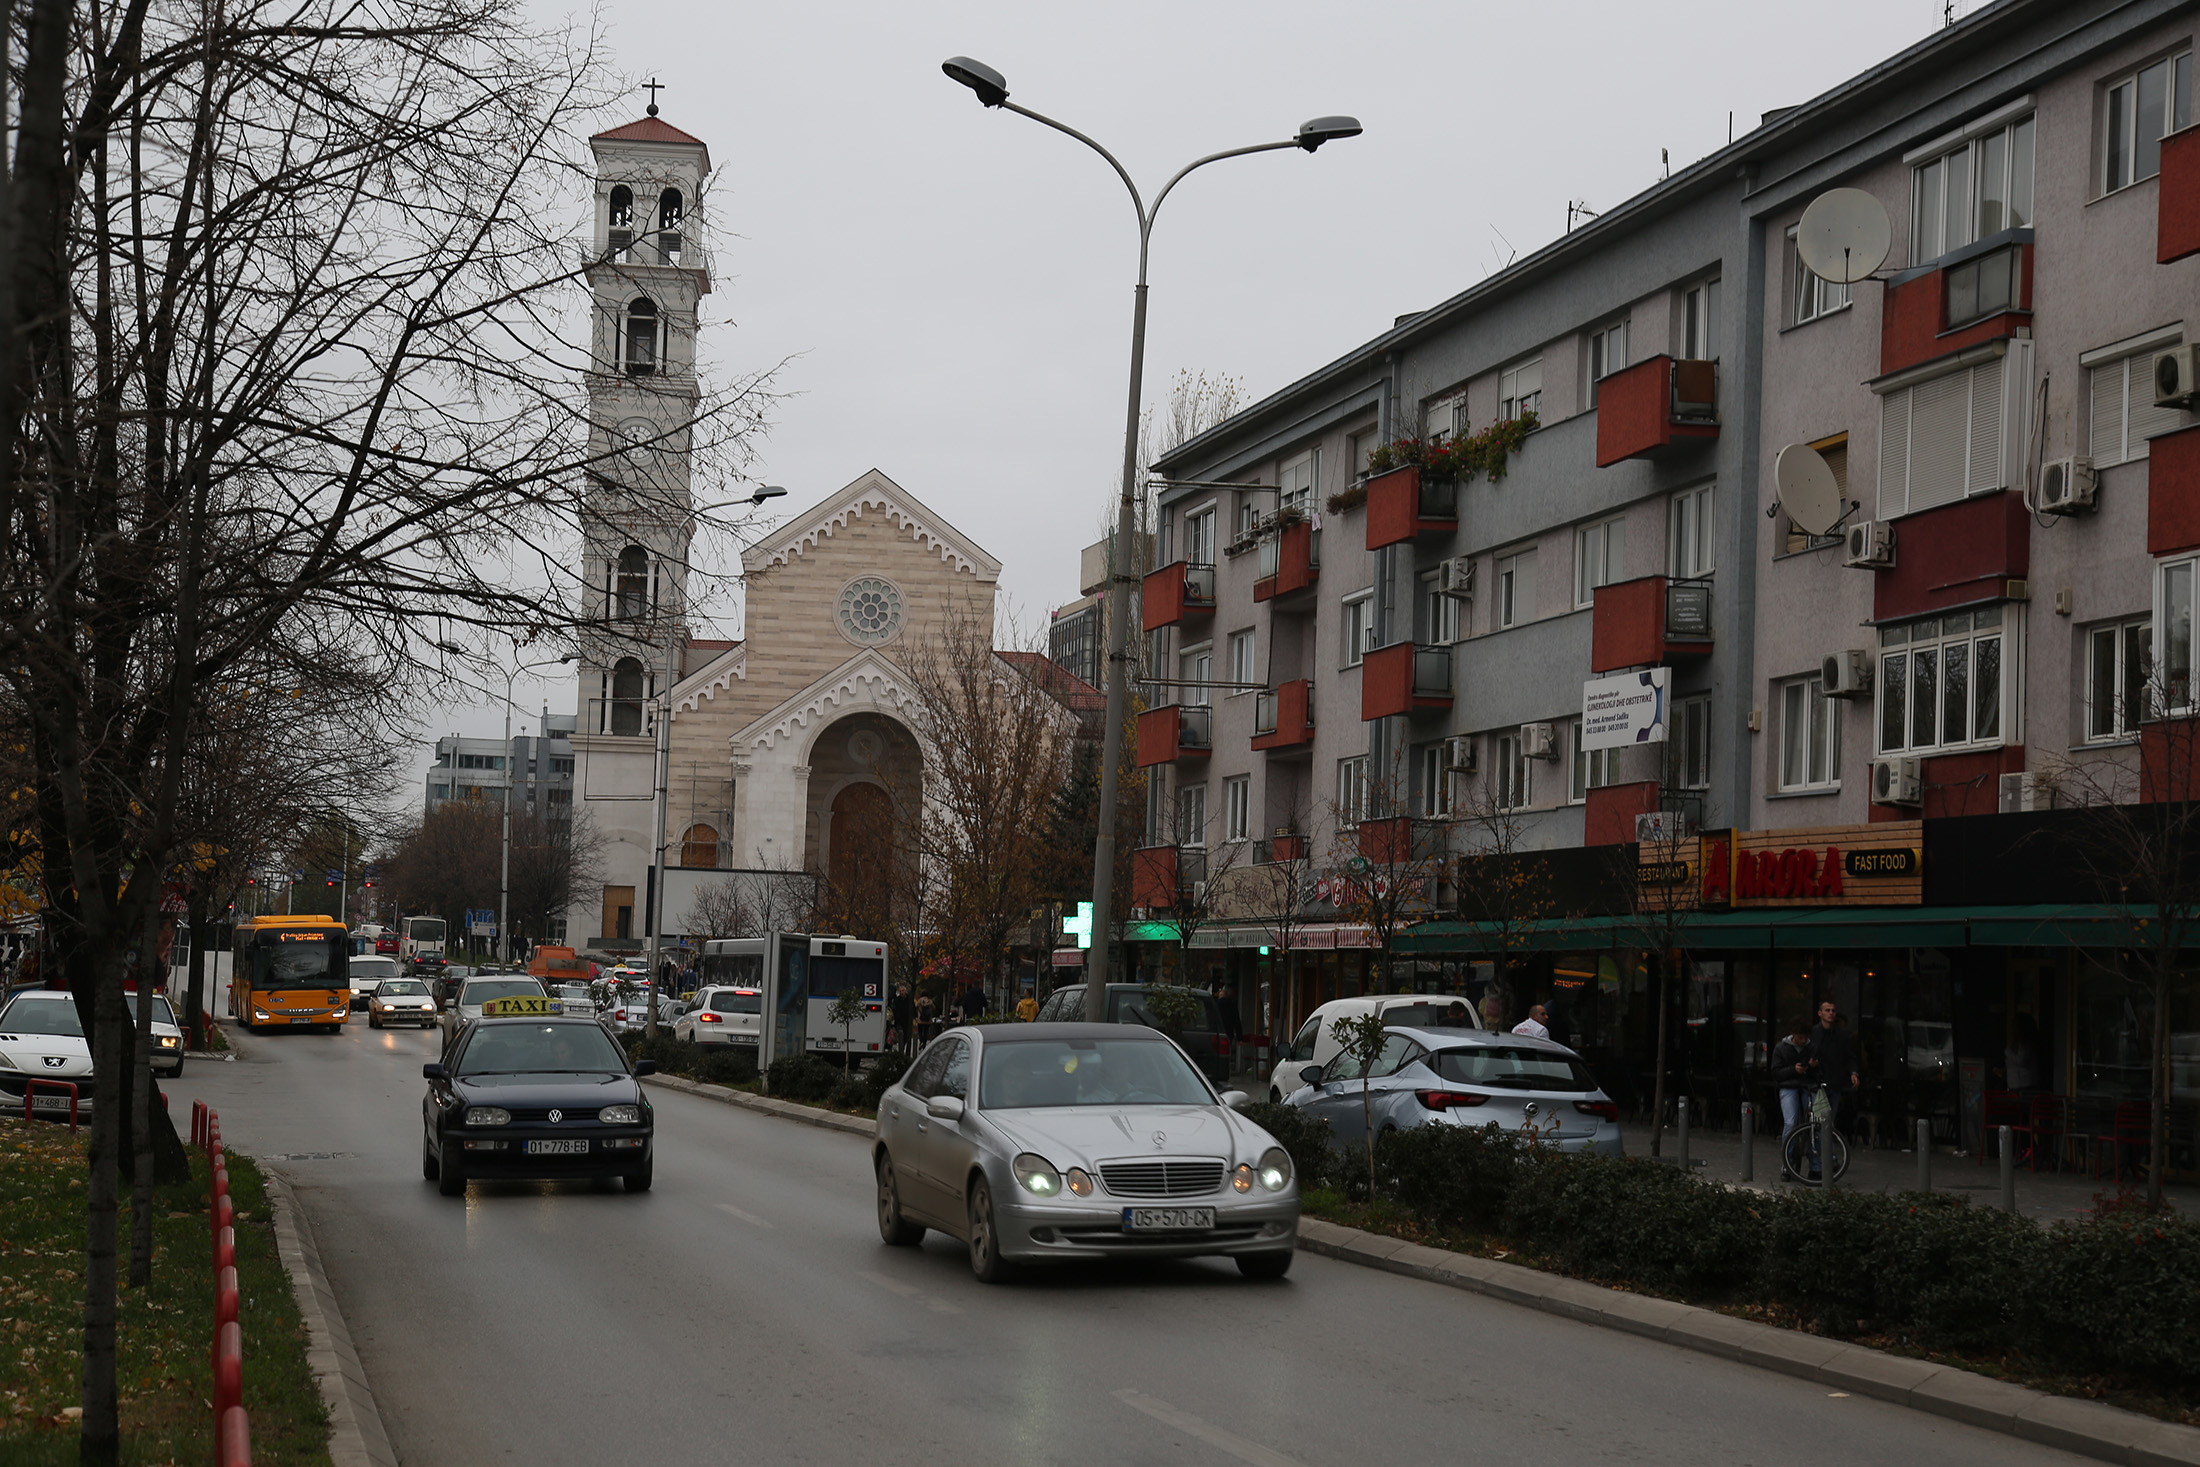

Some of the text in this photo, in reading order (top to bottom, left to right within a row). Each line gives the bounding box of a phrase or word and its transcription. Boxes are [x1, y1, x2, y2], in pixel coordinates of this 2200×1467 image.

[1616, 699, 1625, 707] DHE
[1854, 853, 1906, 871] FAST FOOD
[1702, 839, 1843, 899] AURORA
[866, 984, 875, 995] 3
[499, 1000, 547, 1012] TAXI
